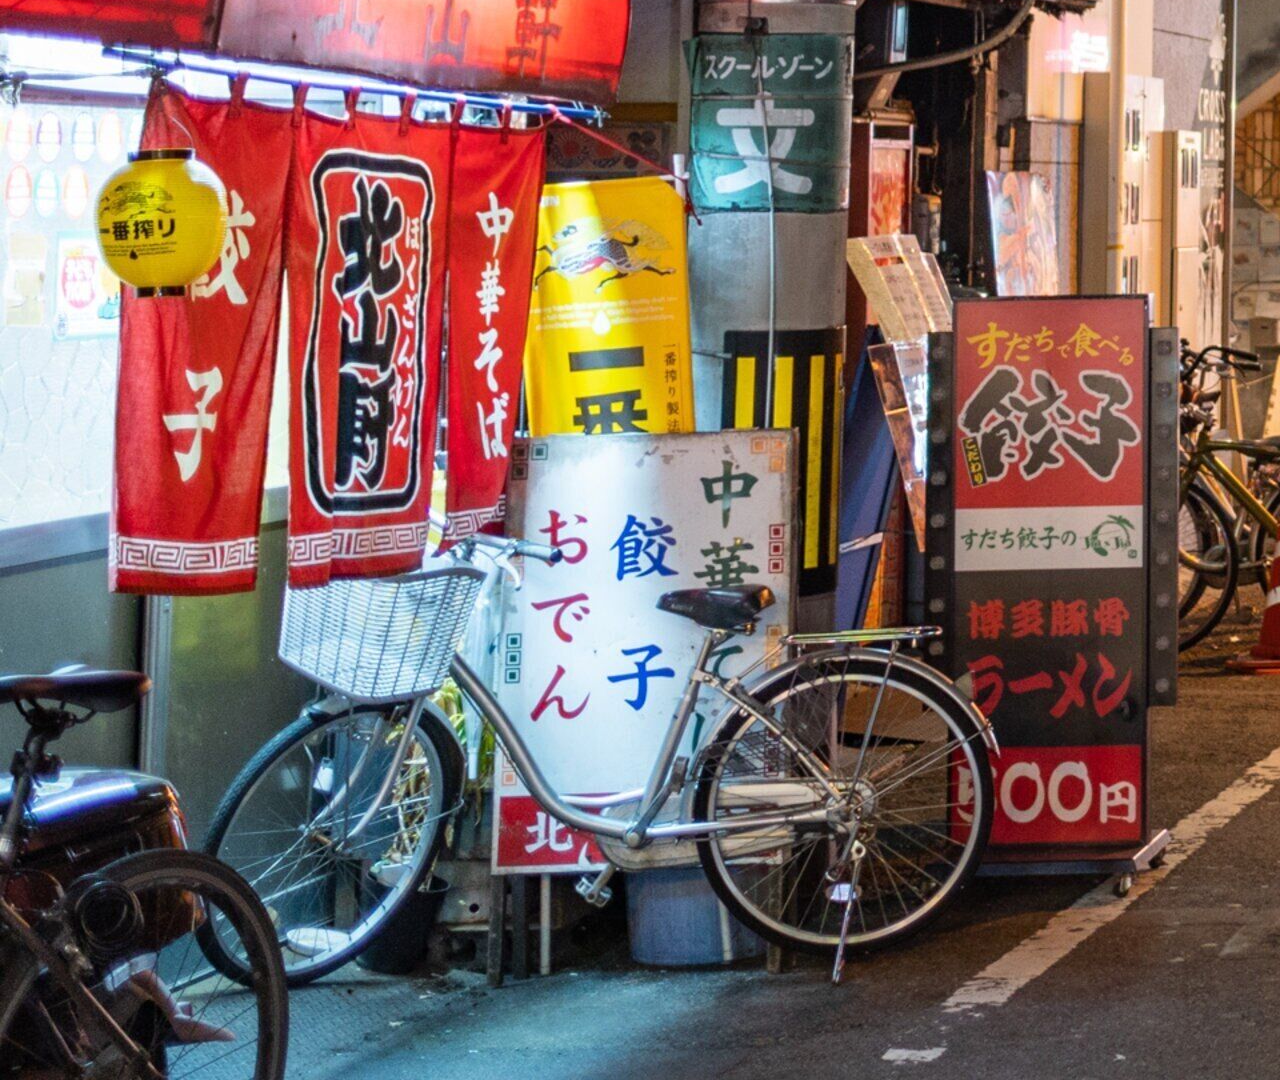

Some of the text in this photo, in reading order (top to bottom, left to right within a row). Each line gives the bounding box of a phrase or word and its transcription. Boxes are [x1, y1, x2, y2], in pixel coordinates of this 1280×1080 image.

[704, 53, 834, 81] スクールゾーン
[473, 191, 516, 462] 中華そば
[966, 321, 1135, 369] すだちで食べる
[958, 365, 1142, 482] 餃子
[960, 526, 1077, 552] すだち餃子の
[530, 509, 590, 722] おでん
[606, 513, 678, 711] 餃子
[966, 596, 1131, 640] 博多豚骨
[966, 651, 1133, 719] ラーメン
